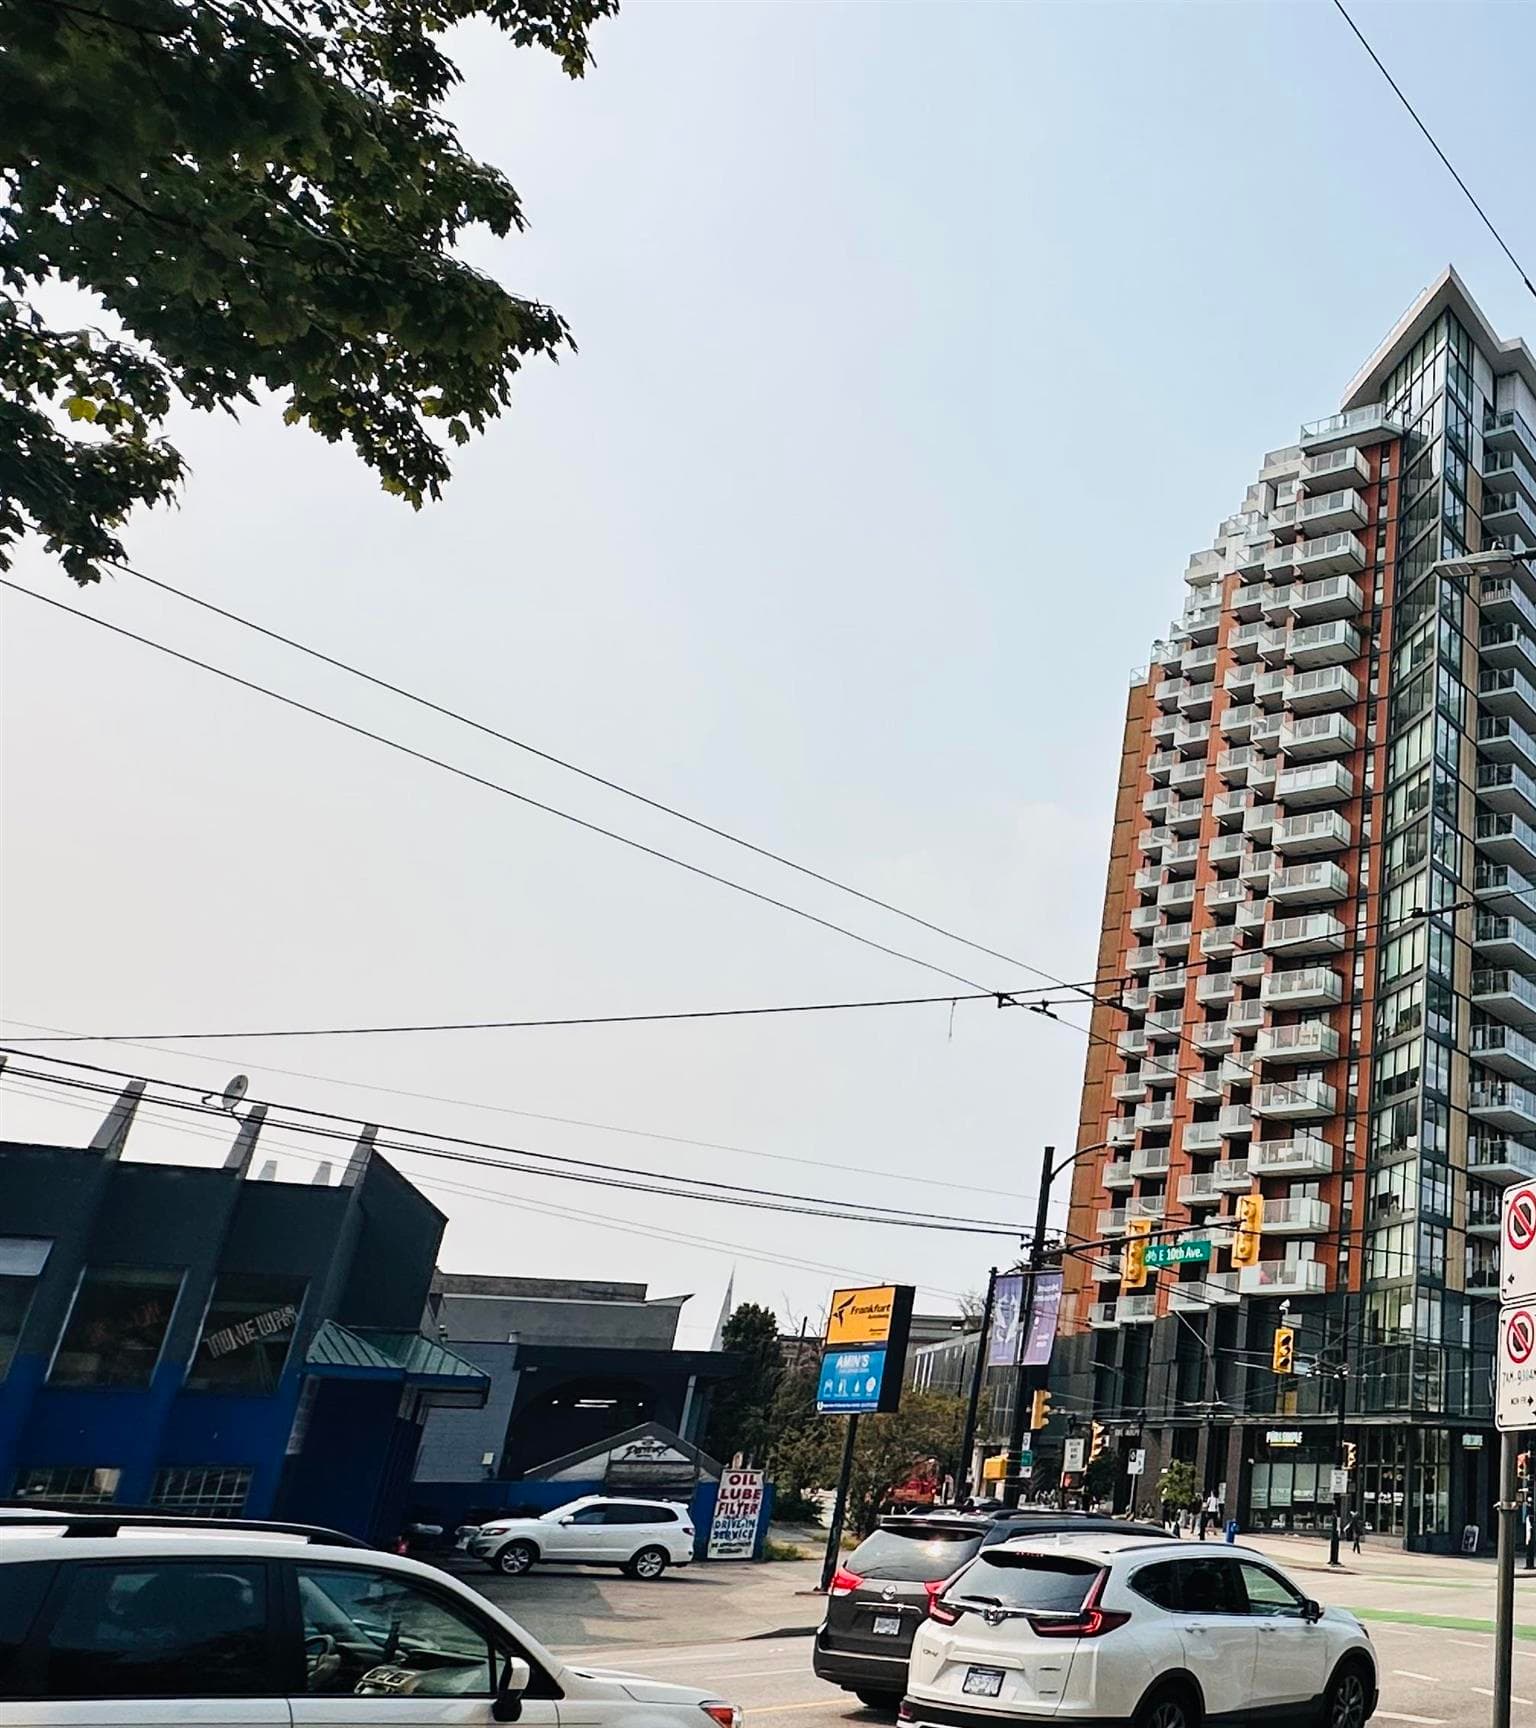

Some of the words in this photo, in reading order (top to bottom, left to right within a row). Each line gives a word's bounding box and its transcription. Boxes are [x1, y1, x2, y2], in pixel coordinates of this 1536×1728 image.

[1159, 1249, 1164, 1261] E
[1166, 1247, 1184, 1261] 10th
[1185, 1246, 1204, 1258] Ave.
[850, 1304, 891, 1315] Frankfurt
[728, 1474, 757, 1486] OIL
[719, 1488, 763, 1500] LUBE
[713, 1528, 754, 1541] SERVICE
